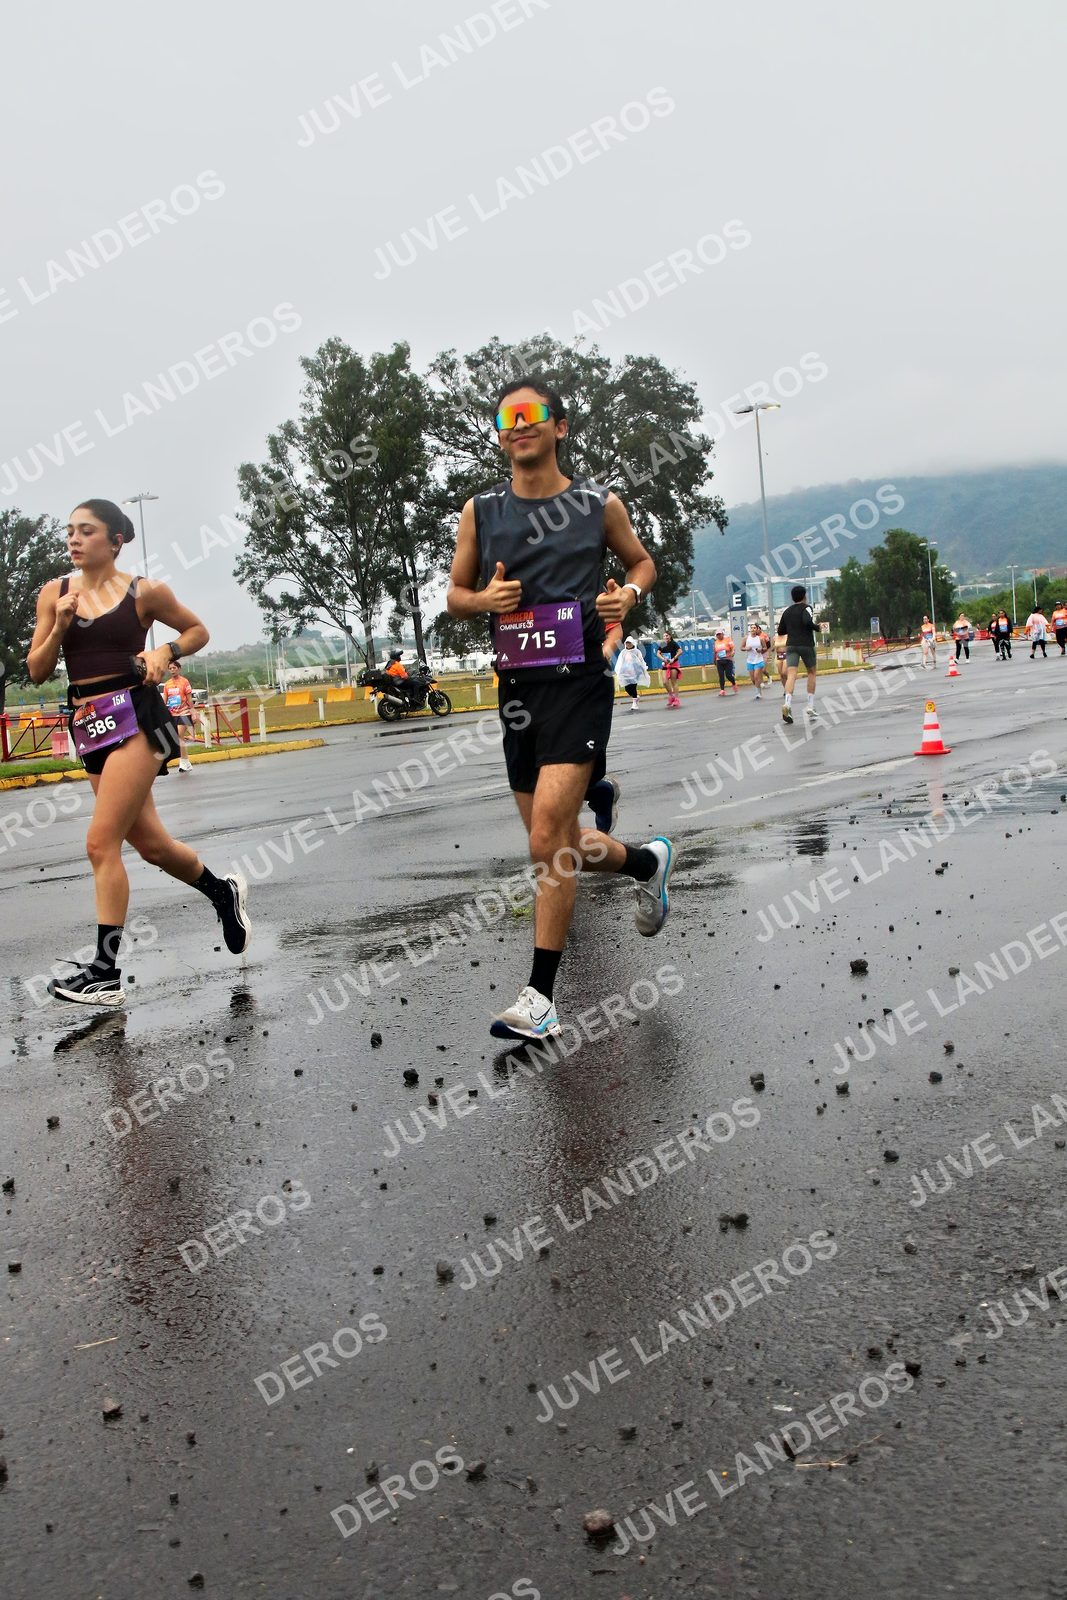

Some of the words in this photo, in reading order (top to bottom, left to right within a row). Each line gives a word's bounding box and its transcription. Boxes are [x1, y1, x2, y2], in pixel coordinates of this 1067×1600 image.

[732, 594, 742, 607] E
[499, 611, 534, 624] CARRERA
[517, 630, 556, 651] 715
[87, 715, 117, 739] 586
